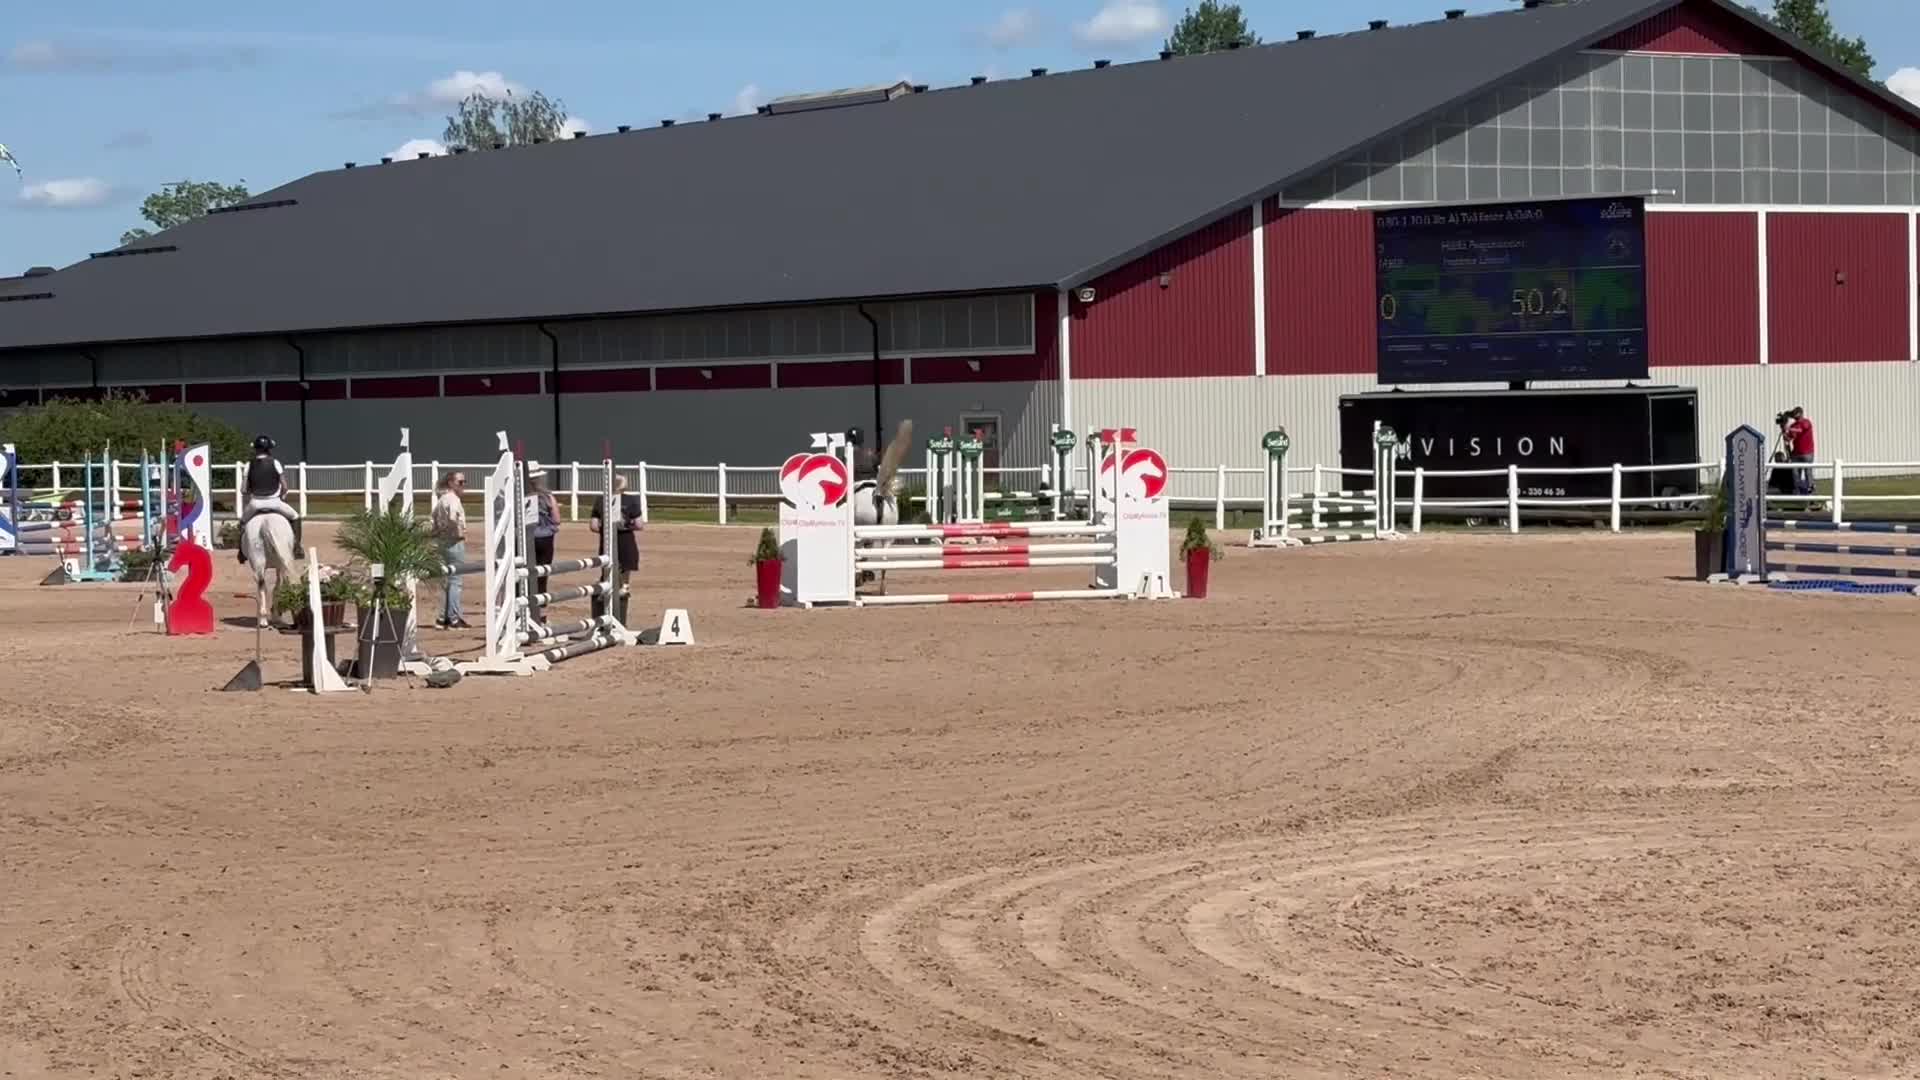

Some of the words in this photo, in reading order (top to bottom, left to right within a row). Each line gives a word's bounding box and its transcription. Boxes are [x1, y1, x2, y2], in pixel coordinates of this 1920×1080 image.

[1381, 294, 1396, 320] 0
[1512, 287, 1568, 316] 50.2
[1421, 436, 1567, 457] VISION
[671, 615, 680, 637] 4
